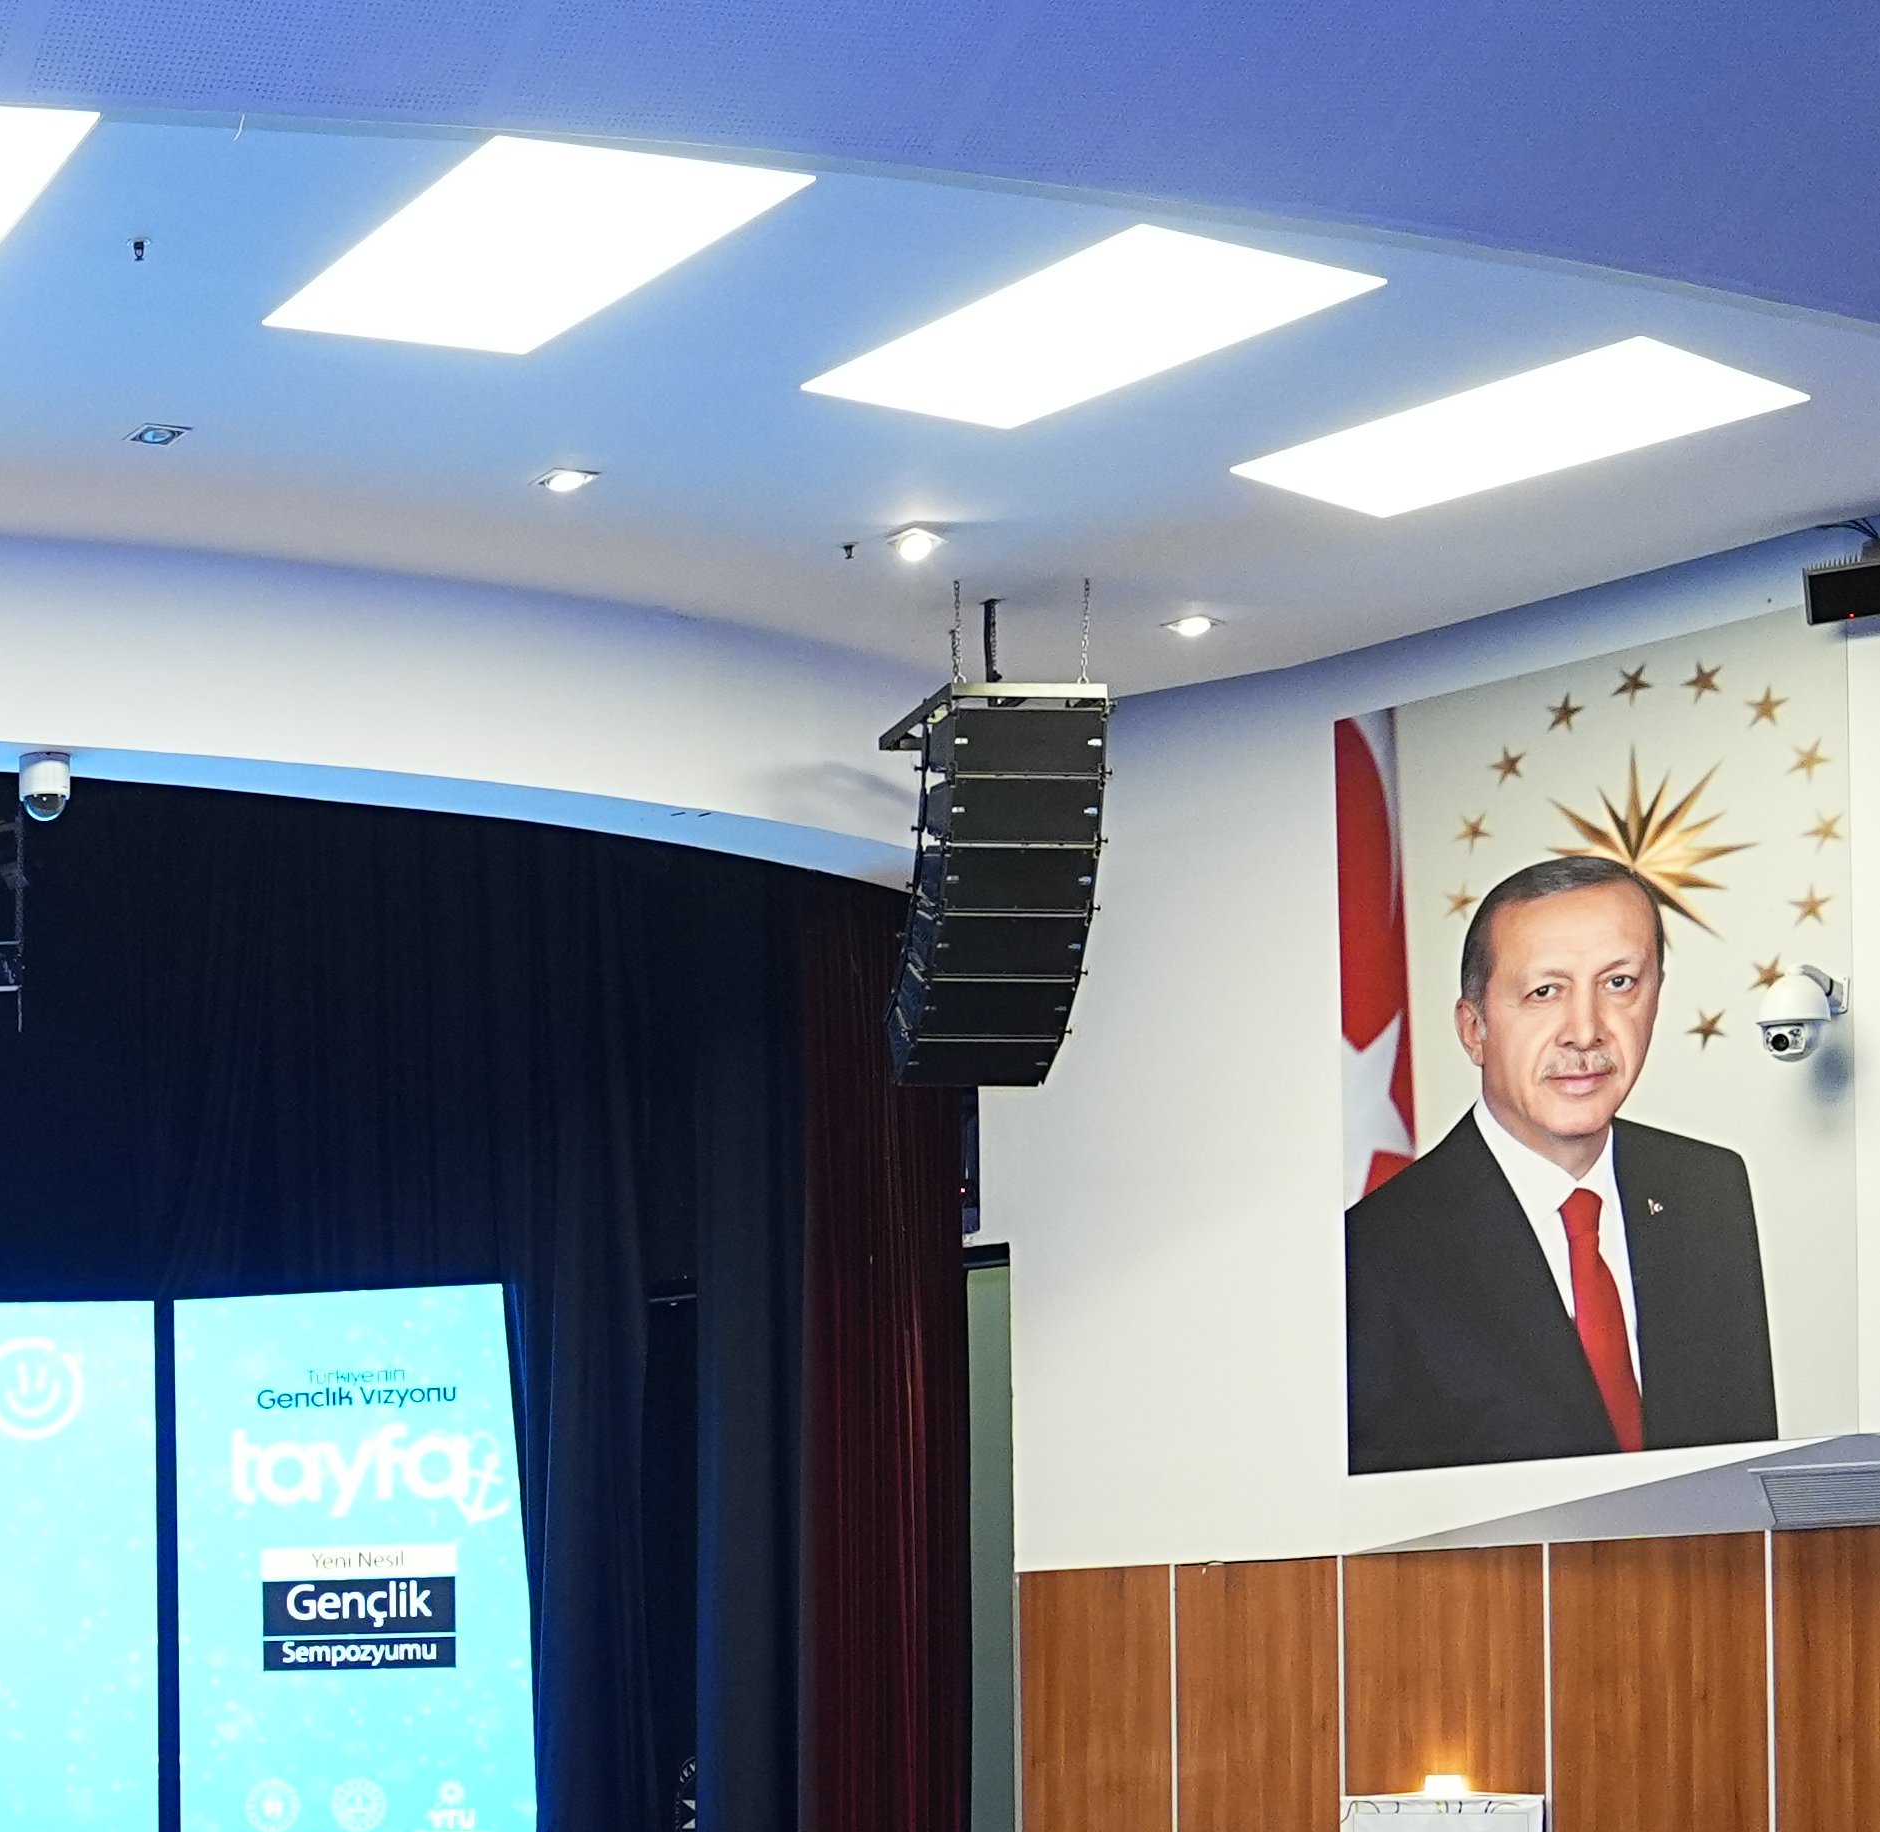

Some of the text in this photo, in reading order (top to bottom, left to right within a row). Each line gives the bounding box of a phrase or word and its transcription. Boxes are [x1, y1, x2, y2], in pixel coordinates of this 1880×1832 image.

[231, 1423, 472, 1517] tayfa
[313, 1552, 403, 1568] Yeni Nesil
[286, 1580, 433, 1627] Gençlik
[282, 1640, 437, 1667] Sempozyumu
